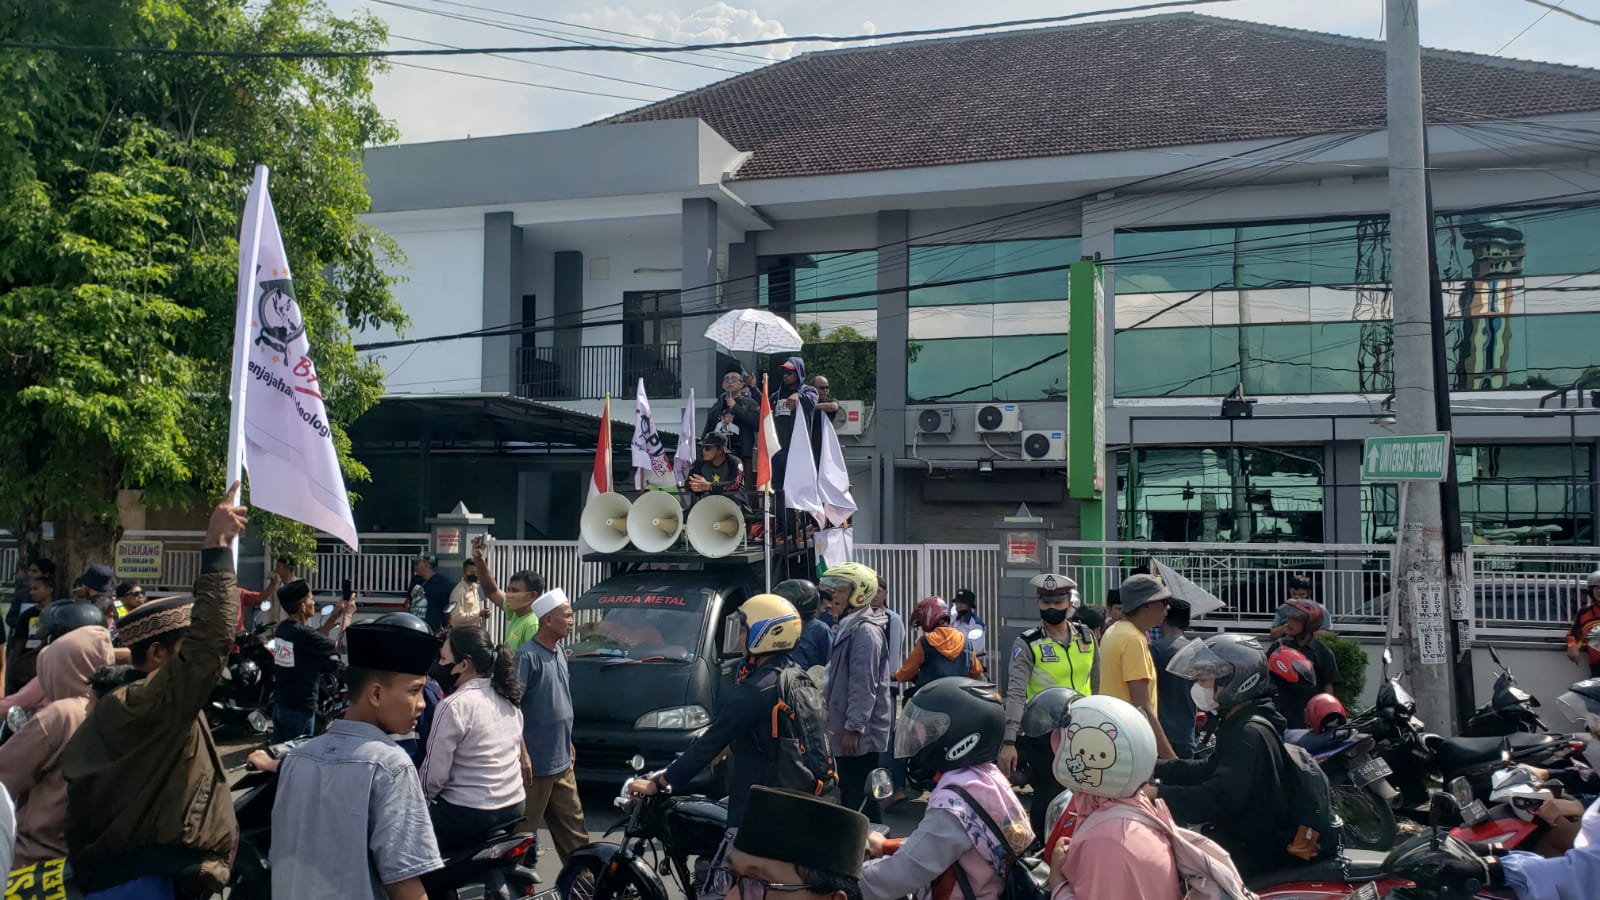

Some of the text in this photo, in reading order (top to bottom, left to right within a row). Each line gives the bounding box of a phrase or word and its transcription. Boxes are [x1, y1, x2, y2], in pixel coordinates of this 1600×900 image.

[1380, 441, 1443, 473] UNIVERSITAS TERBUKA
[119, 544, 160, 556] DILARANG
[598, 595, 686, 606] GARDA METAL
